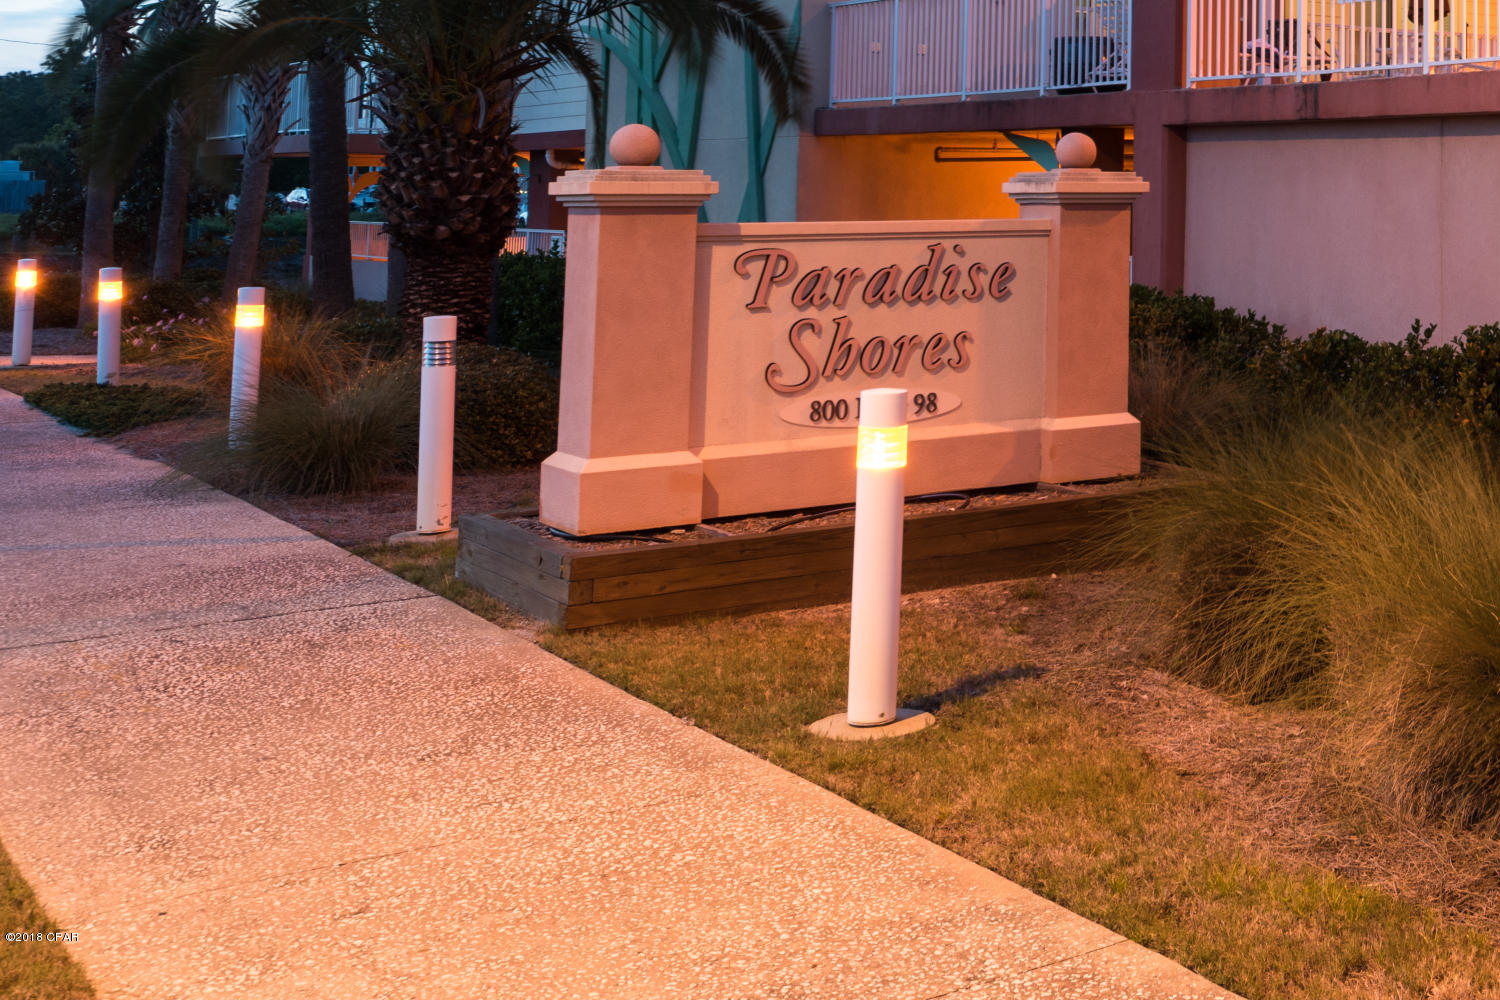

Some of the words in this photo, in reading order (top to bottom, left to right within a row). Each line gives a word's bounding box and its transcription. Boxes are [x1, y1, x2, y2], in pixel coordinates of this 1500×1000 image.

[734, 243, 1017, 312] Paradise
[764, 314, 973, 395] Shores
[809, 399, 848, 422] 800
[913, 392, 938, 414] 98
